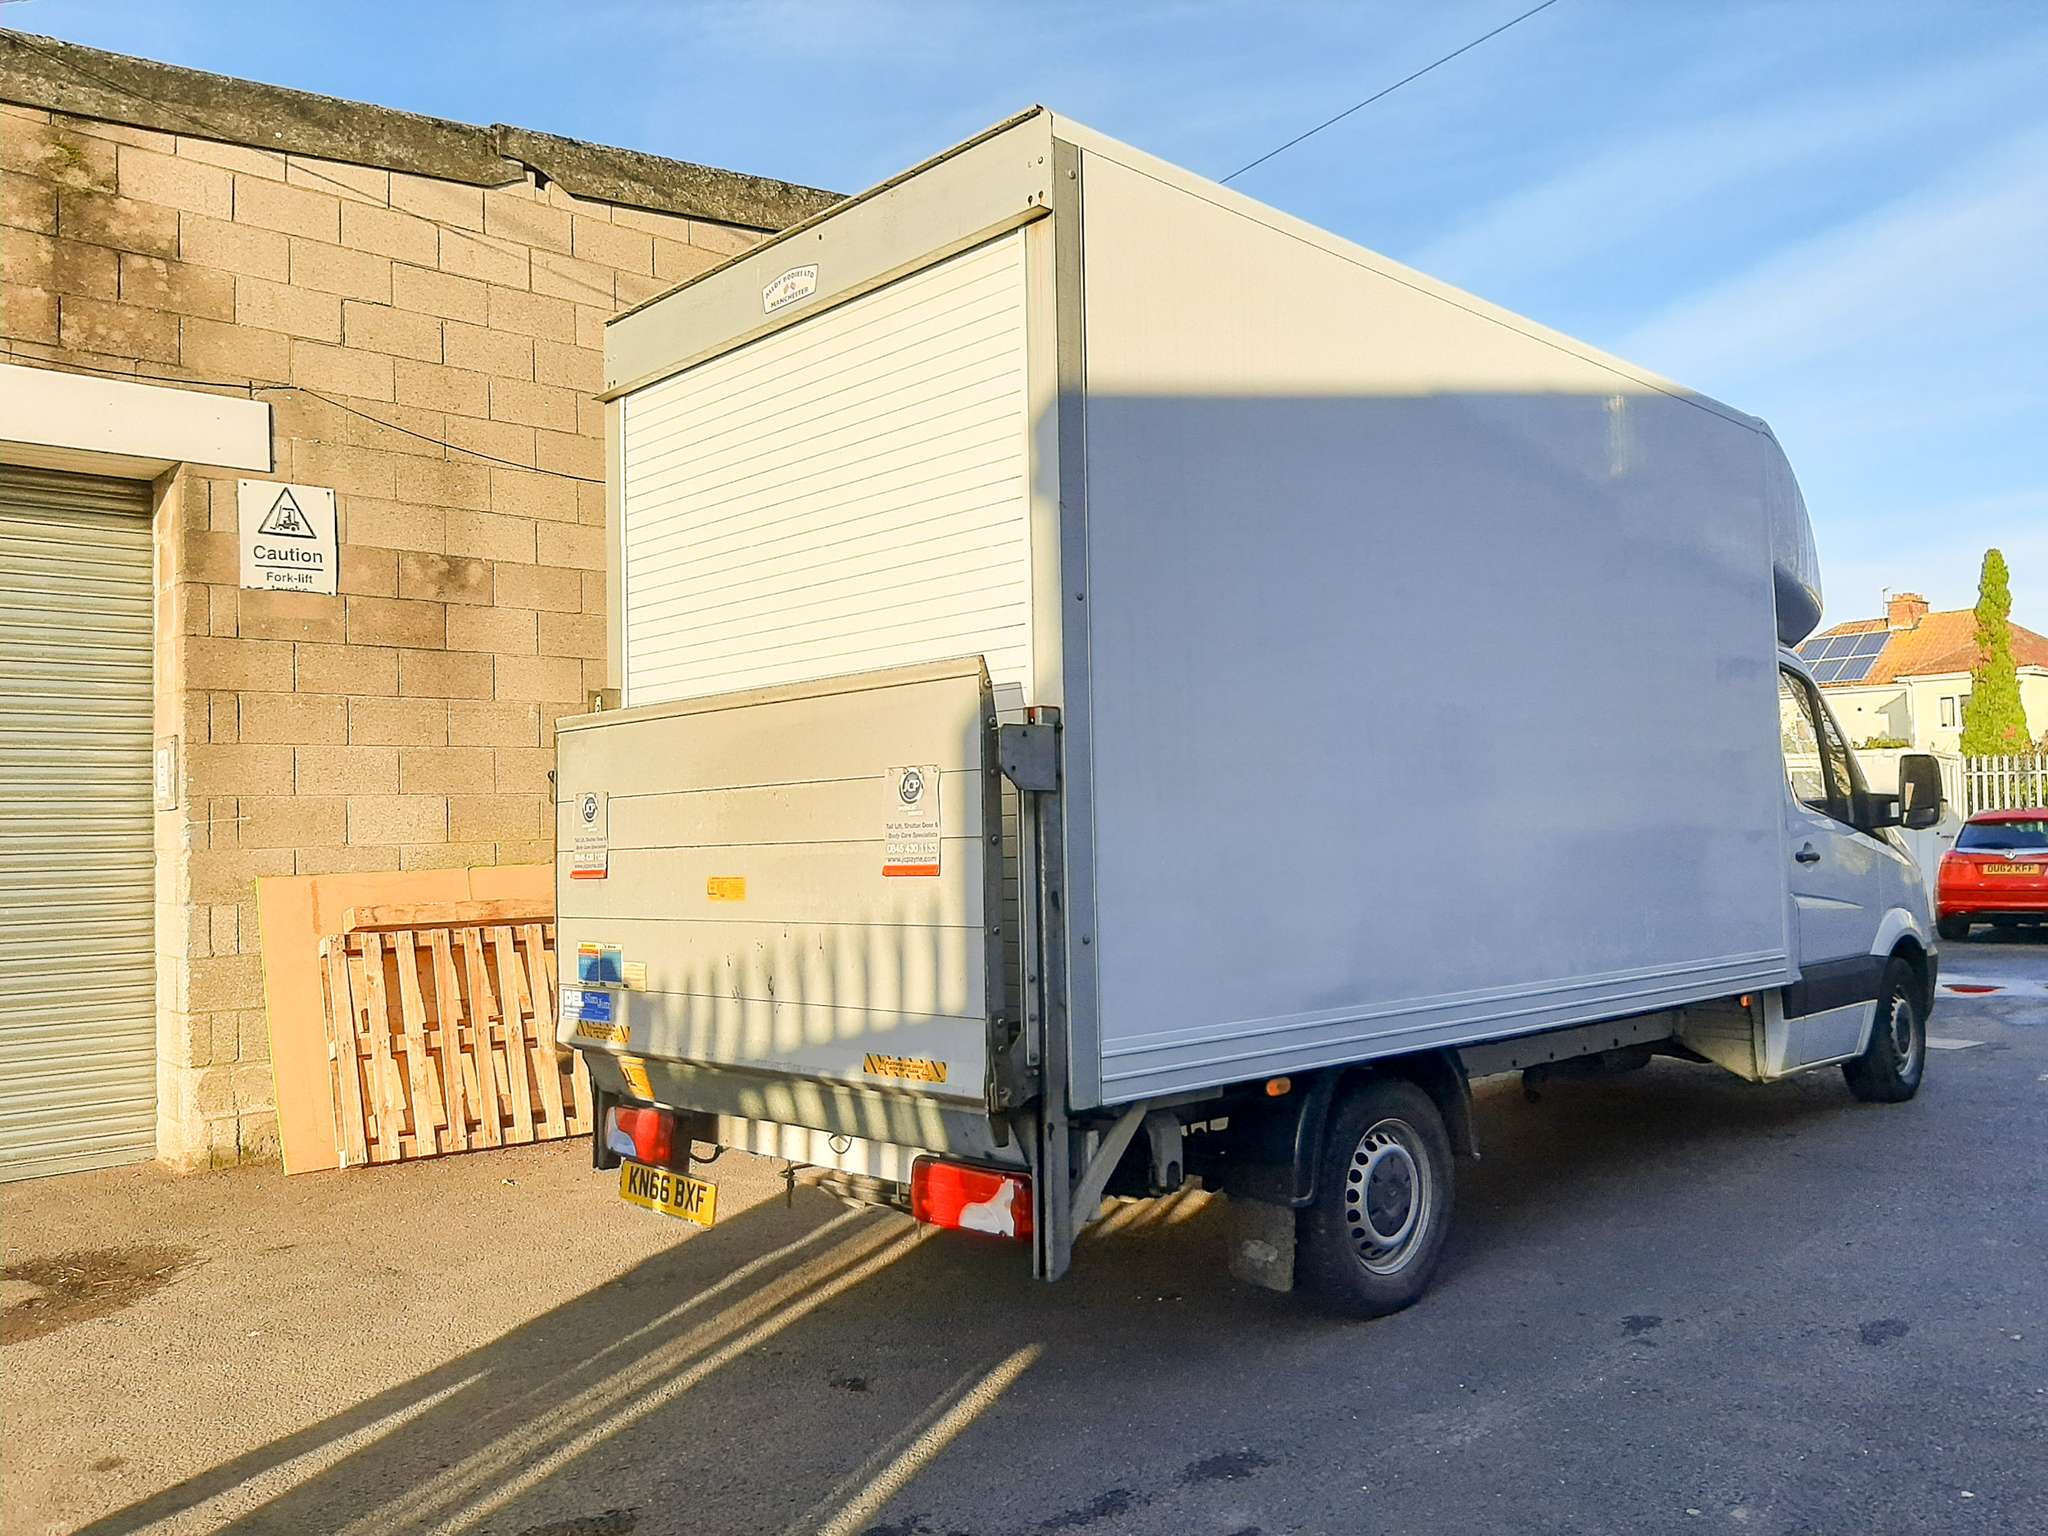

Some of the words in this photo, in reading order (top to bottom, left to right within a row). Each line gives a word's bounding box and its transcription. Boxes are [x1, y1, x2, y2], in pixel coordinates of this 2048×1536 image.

[253, 545, 323, 563] Caution
[266, 571, 313, 584] Fork-lift
[627, 1165, 671, 1204] KN66
[674, 1177, 708, 1213] BXF
